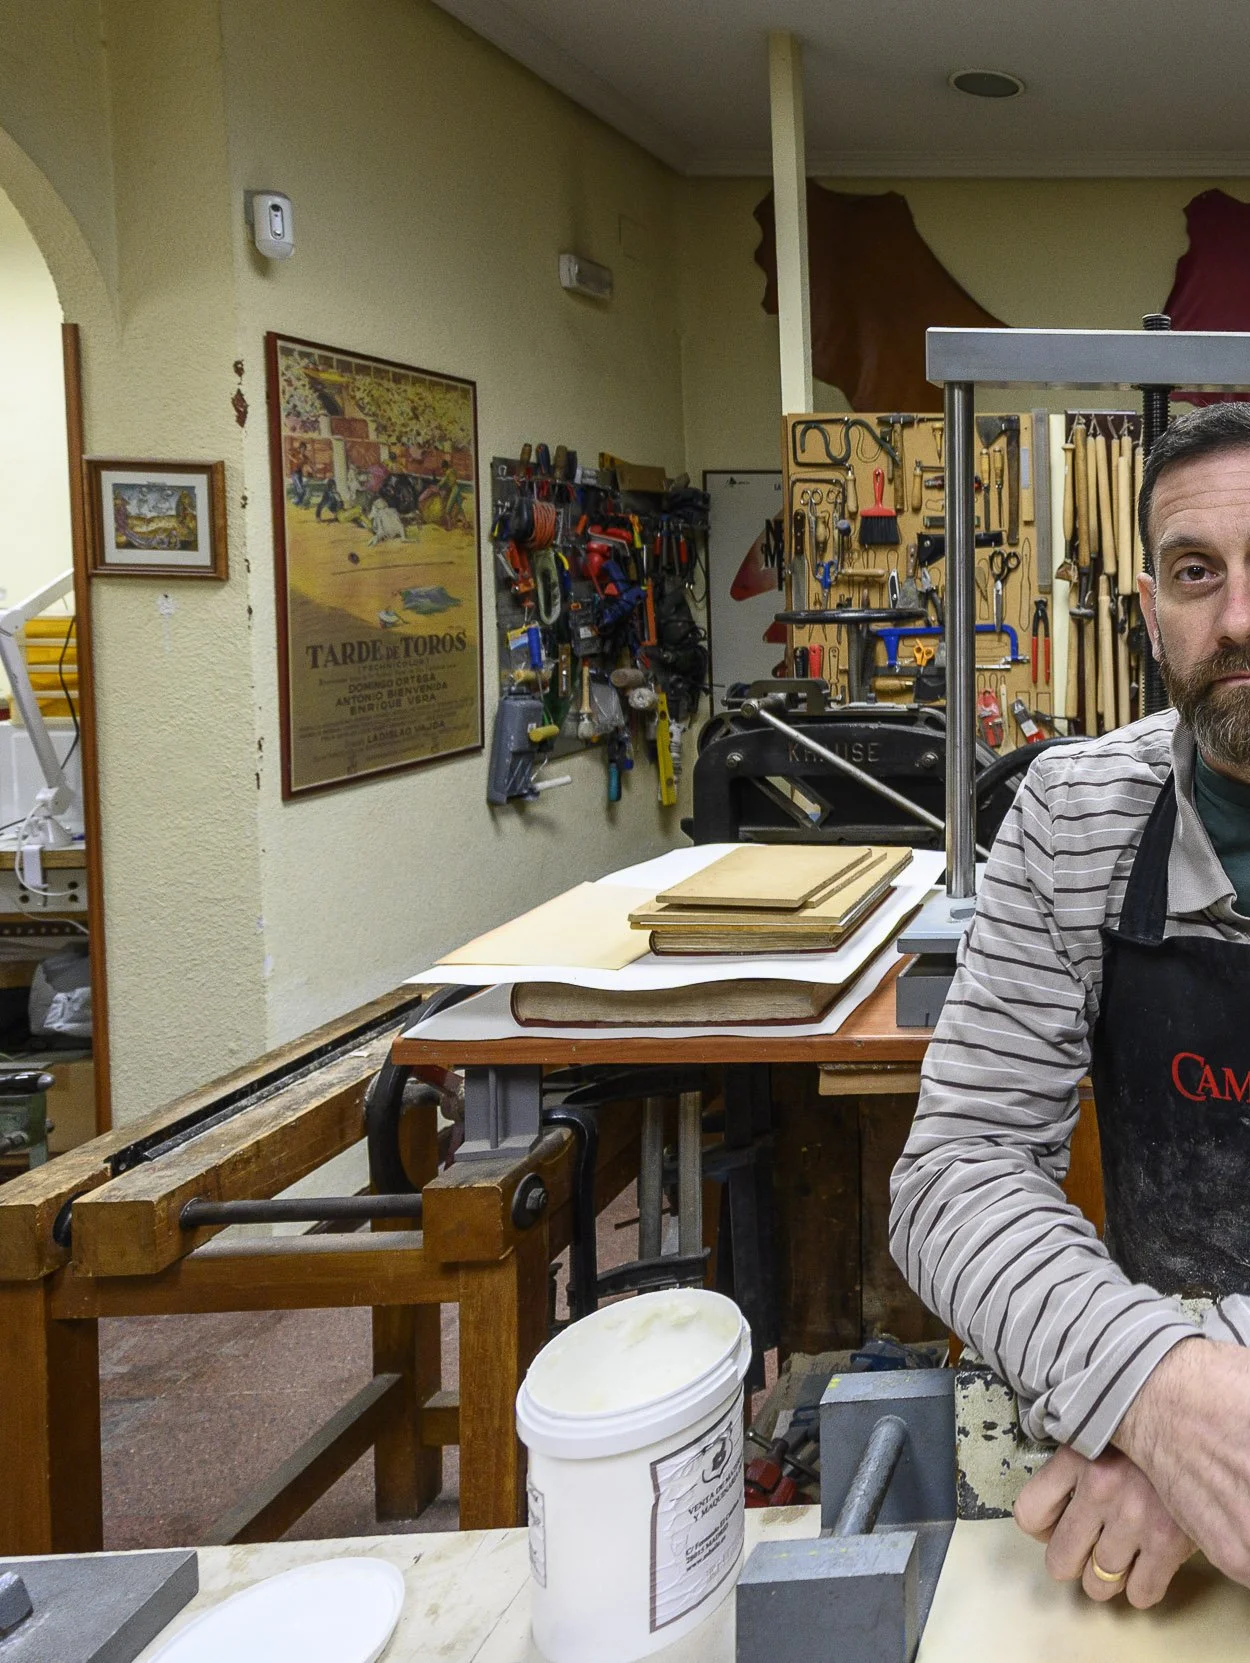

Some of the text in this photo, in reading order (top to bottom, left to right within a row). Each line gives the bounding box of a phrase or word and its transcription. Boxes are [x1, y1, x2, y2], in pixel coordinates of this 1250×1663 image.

[306, 631, 467, 668] TARDE DE TOROS
[335, 681, 448, 707] ANTONIO BIENVENIDA
[348, 678, 394, 694] DOMINGO
[395, 672, 437, 687] ORTEGA
[349, 694, 437, 716] ENRIQUE VERA
[788, 742, 881, 764] KRUSE
[688, 1492, 714, 1515] VENTA
[693, 1512, 701, 1524] Y
